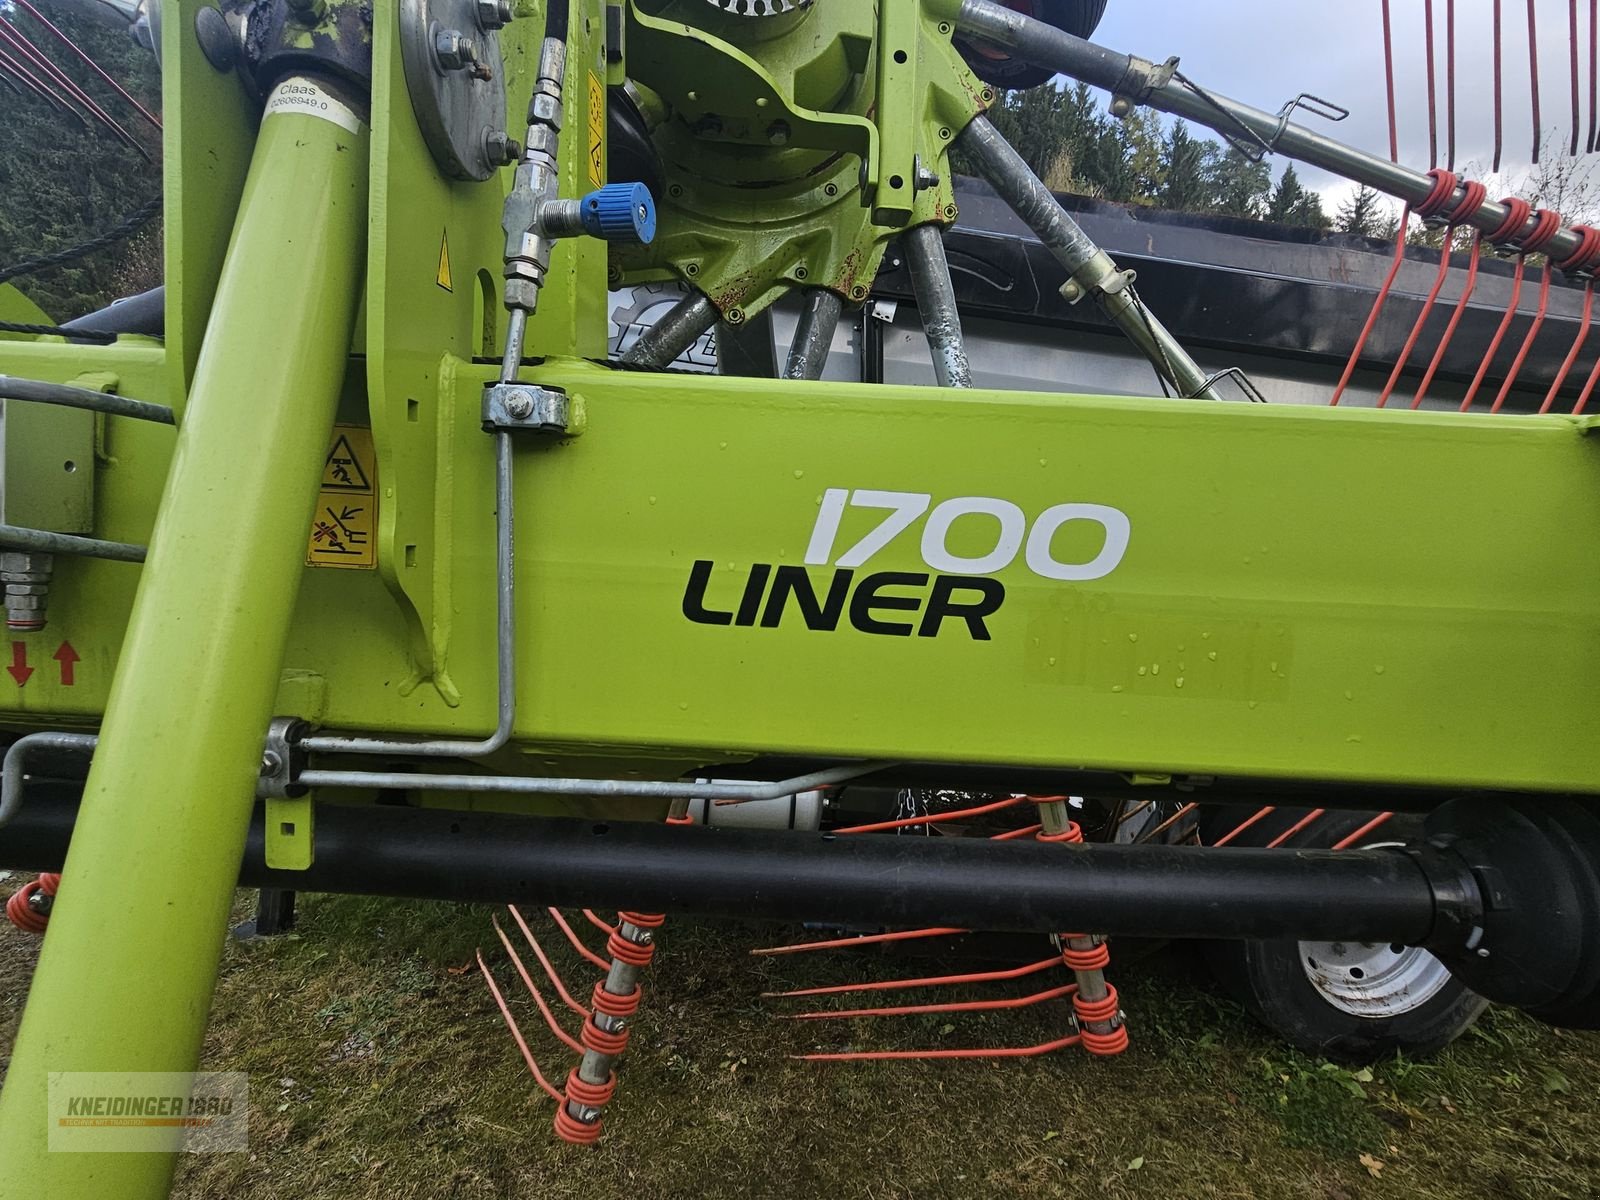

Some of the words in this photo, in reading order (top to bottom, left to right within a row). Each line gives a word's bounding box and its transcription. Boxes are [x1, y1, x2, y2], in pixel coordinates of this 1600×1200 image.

[280, 84, 316, 95] Claas
[804, 488, 1131, 581] 1700
[681, 560, 1006, 641] LINER
